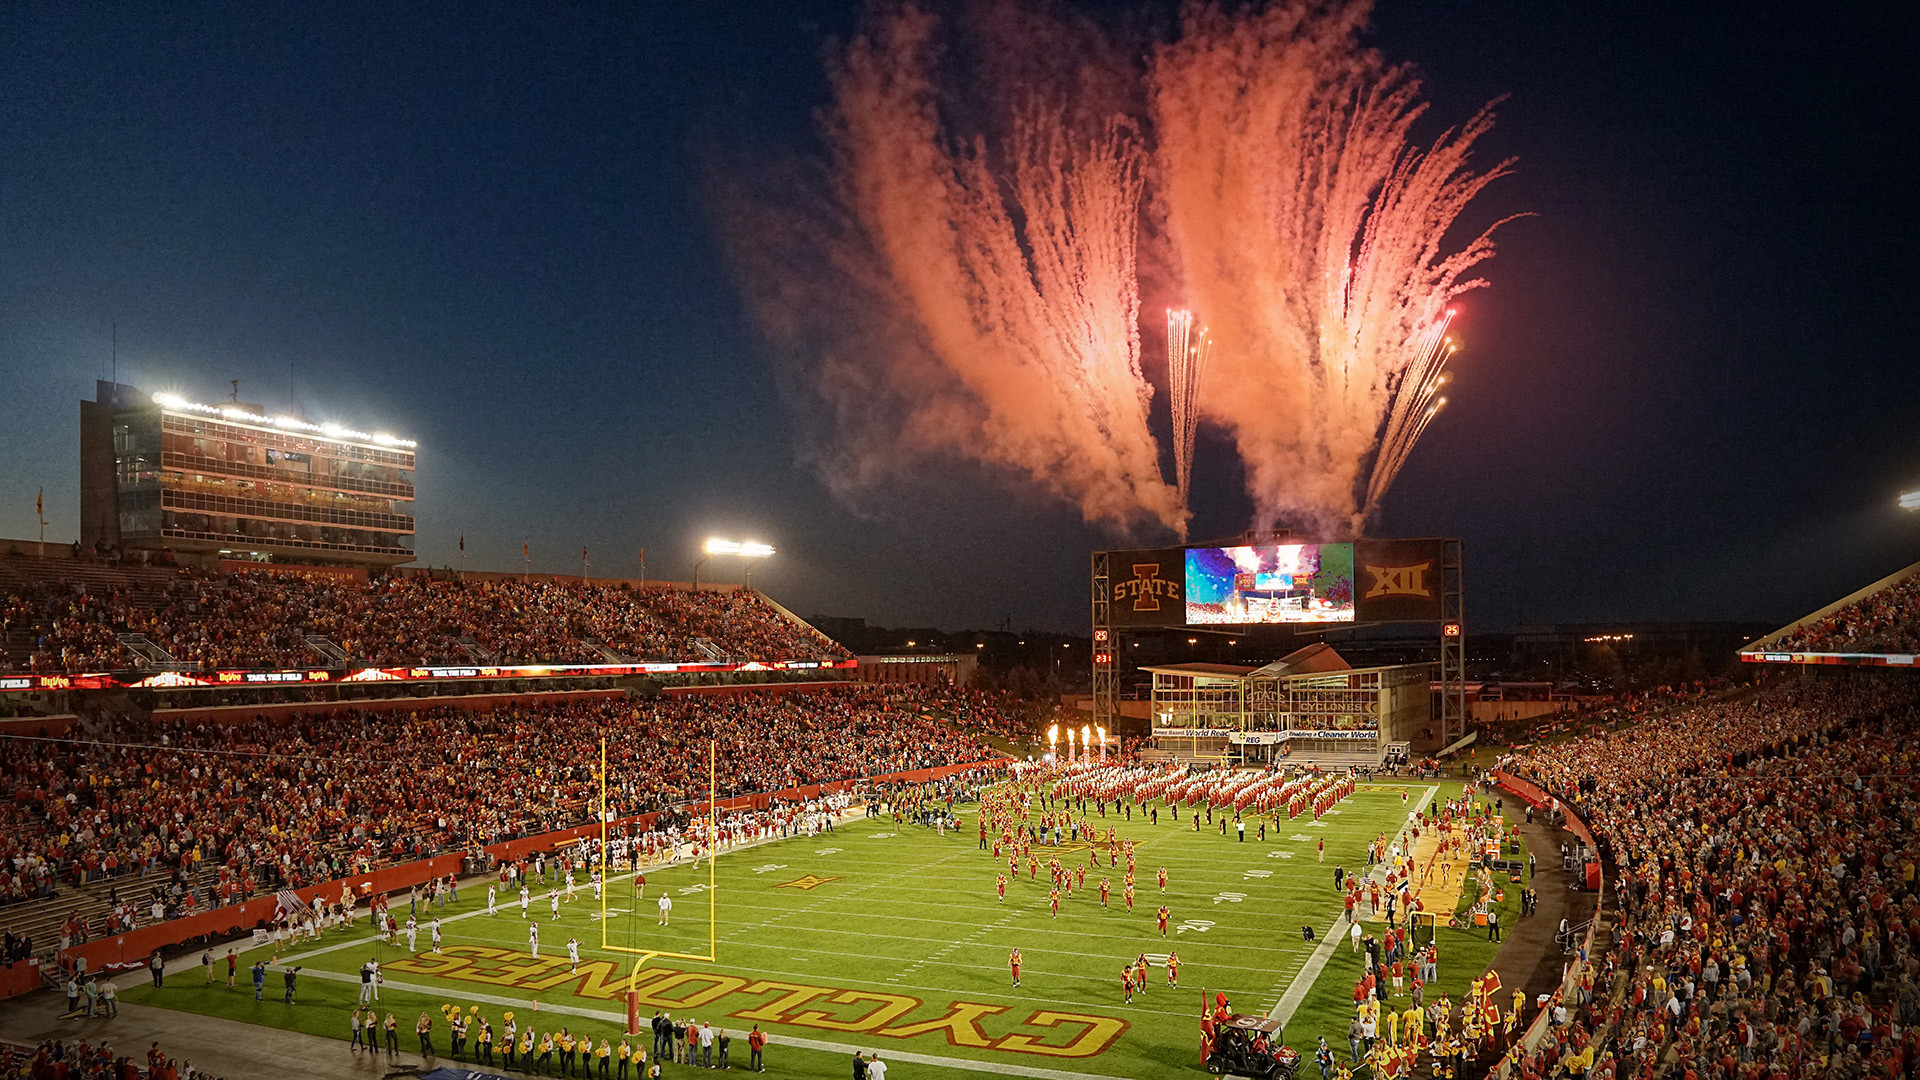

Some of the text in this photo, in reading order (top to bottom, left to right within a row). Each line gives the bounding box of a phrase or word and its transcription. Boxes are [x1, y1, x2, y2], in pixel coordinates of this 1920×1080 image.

[1365, 563, 1430, 598] XII
[1114, 579, 1179, 600] STATE
[1096, 631, 1106, 639] 25
[1445, 626, 1458, 635] 25
[1096, 655, 1111, 663] 2:31
[1300, 702, 1362, 711] CYCLONES
[1318, 730, 1349, 738] Cleaner
[1350, 731, 1378, 739] World.
[1245, 736, 1261, 744] REG
[1177, 919, 1216, 935] 20
[381, 945, 1131, 1059] CYCLONES
